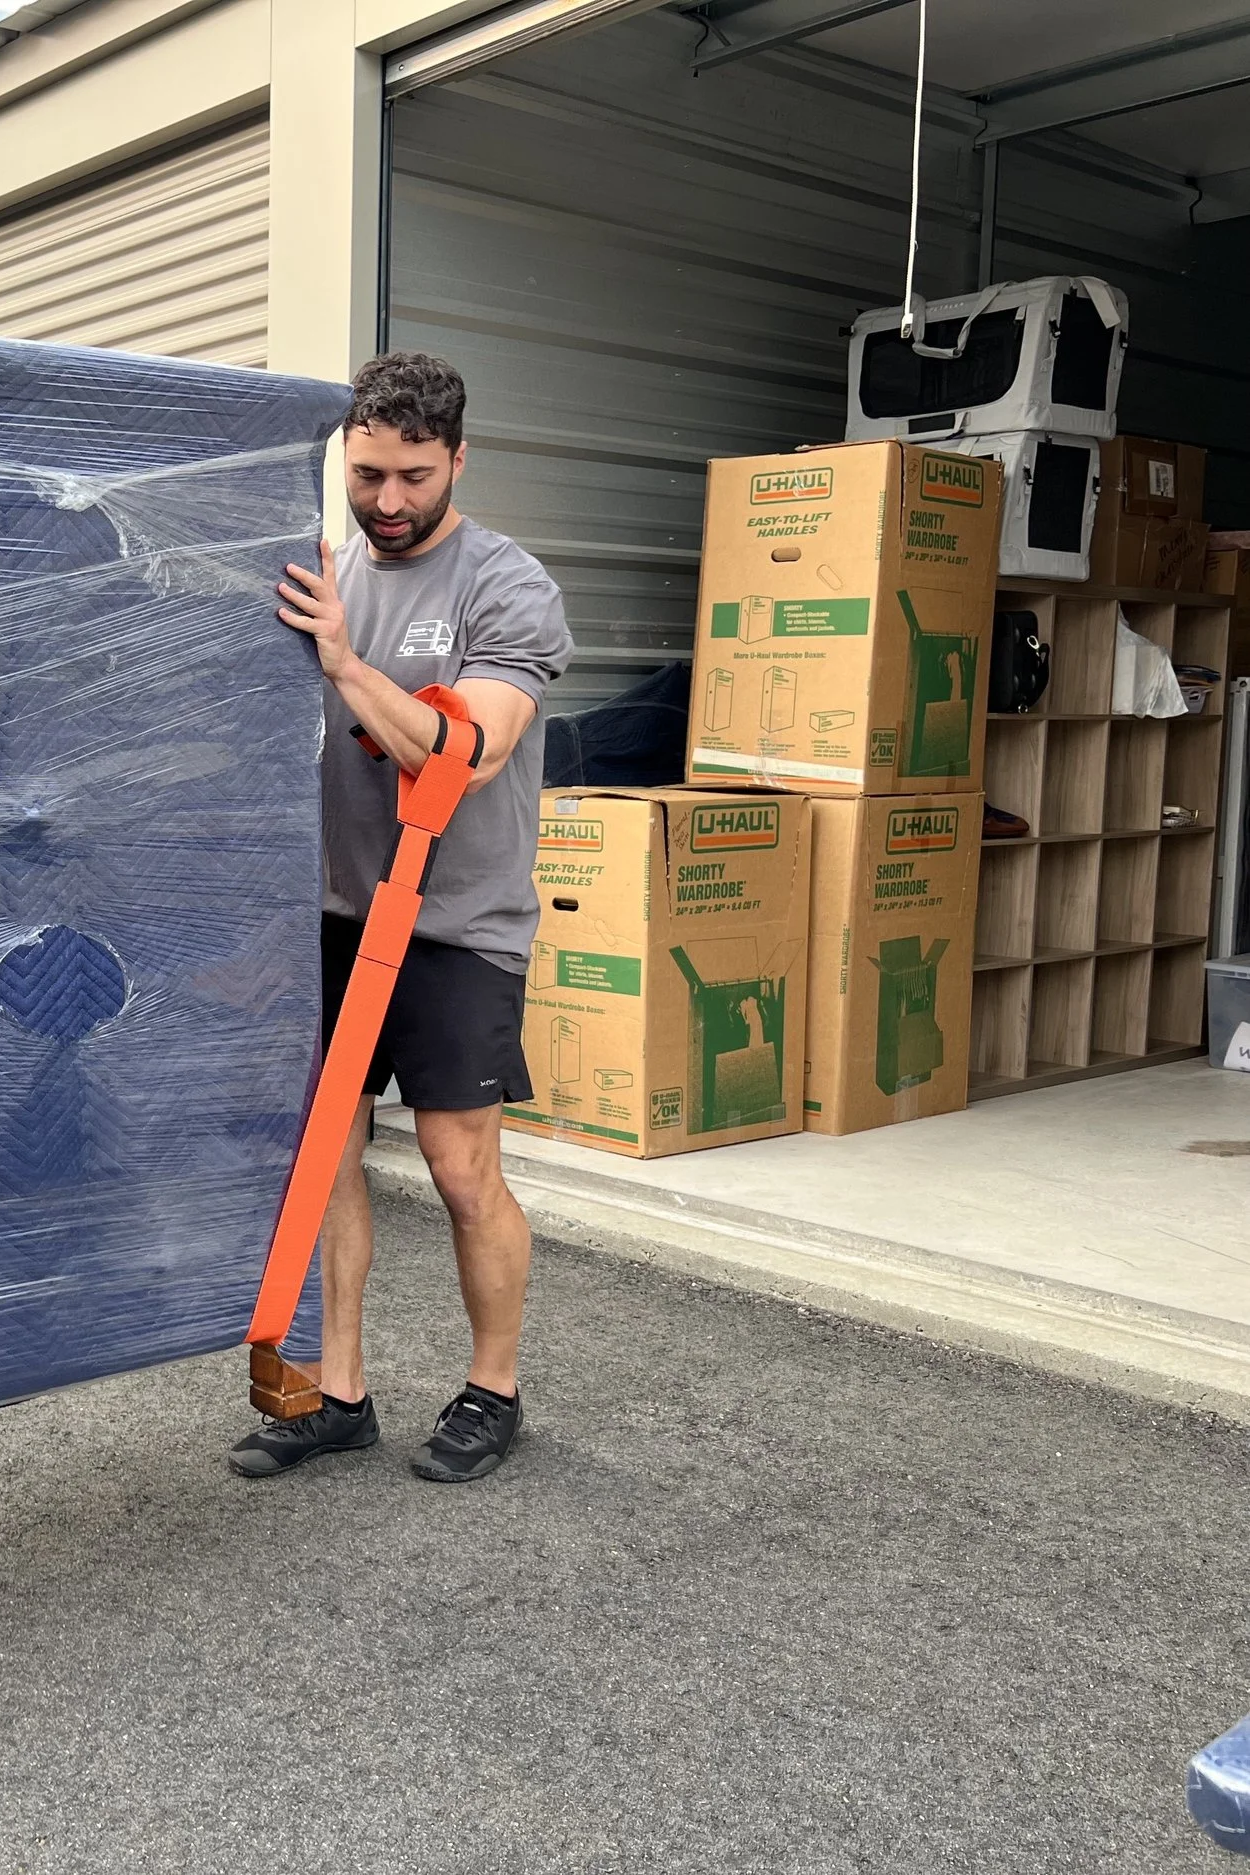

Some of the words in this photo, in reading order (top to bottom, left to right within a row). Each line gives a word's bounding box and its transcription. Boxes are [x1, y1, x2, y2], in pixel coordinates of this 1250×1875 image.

[756, 473, 827, 492] U-HAUL
[925, 461, 980, 489] U-HAUL
[747, 512, 833, 527] EASY-TO-LIFT
[909, 510, 945, 530] SHORTY
[757, 525, 818, 538] HANDLES
[907, 530, 959, 551] WARDROBE
[880, 745, 894, 757] OK
[697, 811, 774, 834] U-HAUL
[892, 814, 954, 836] U-HAUL
[539, 875, 592, 886] HANDLES
[678, 863, 726, 882] SHORTY
[876, 863, 914, 880] SHORTY
[677, 882, 744, 902] WARDROBE
[875, 880, 928, 899] WARDROBE
[752, 900, 761, 908] FT
[662, 1104, 680, 1118] OK
